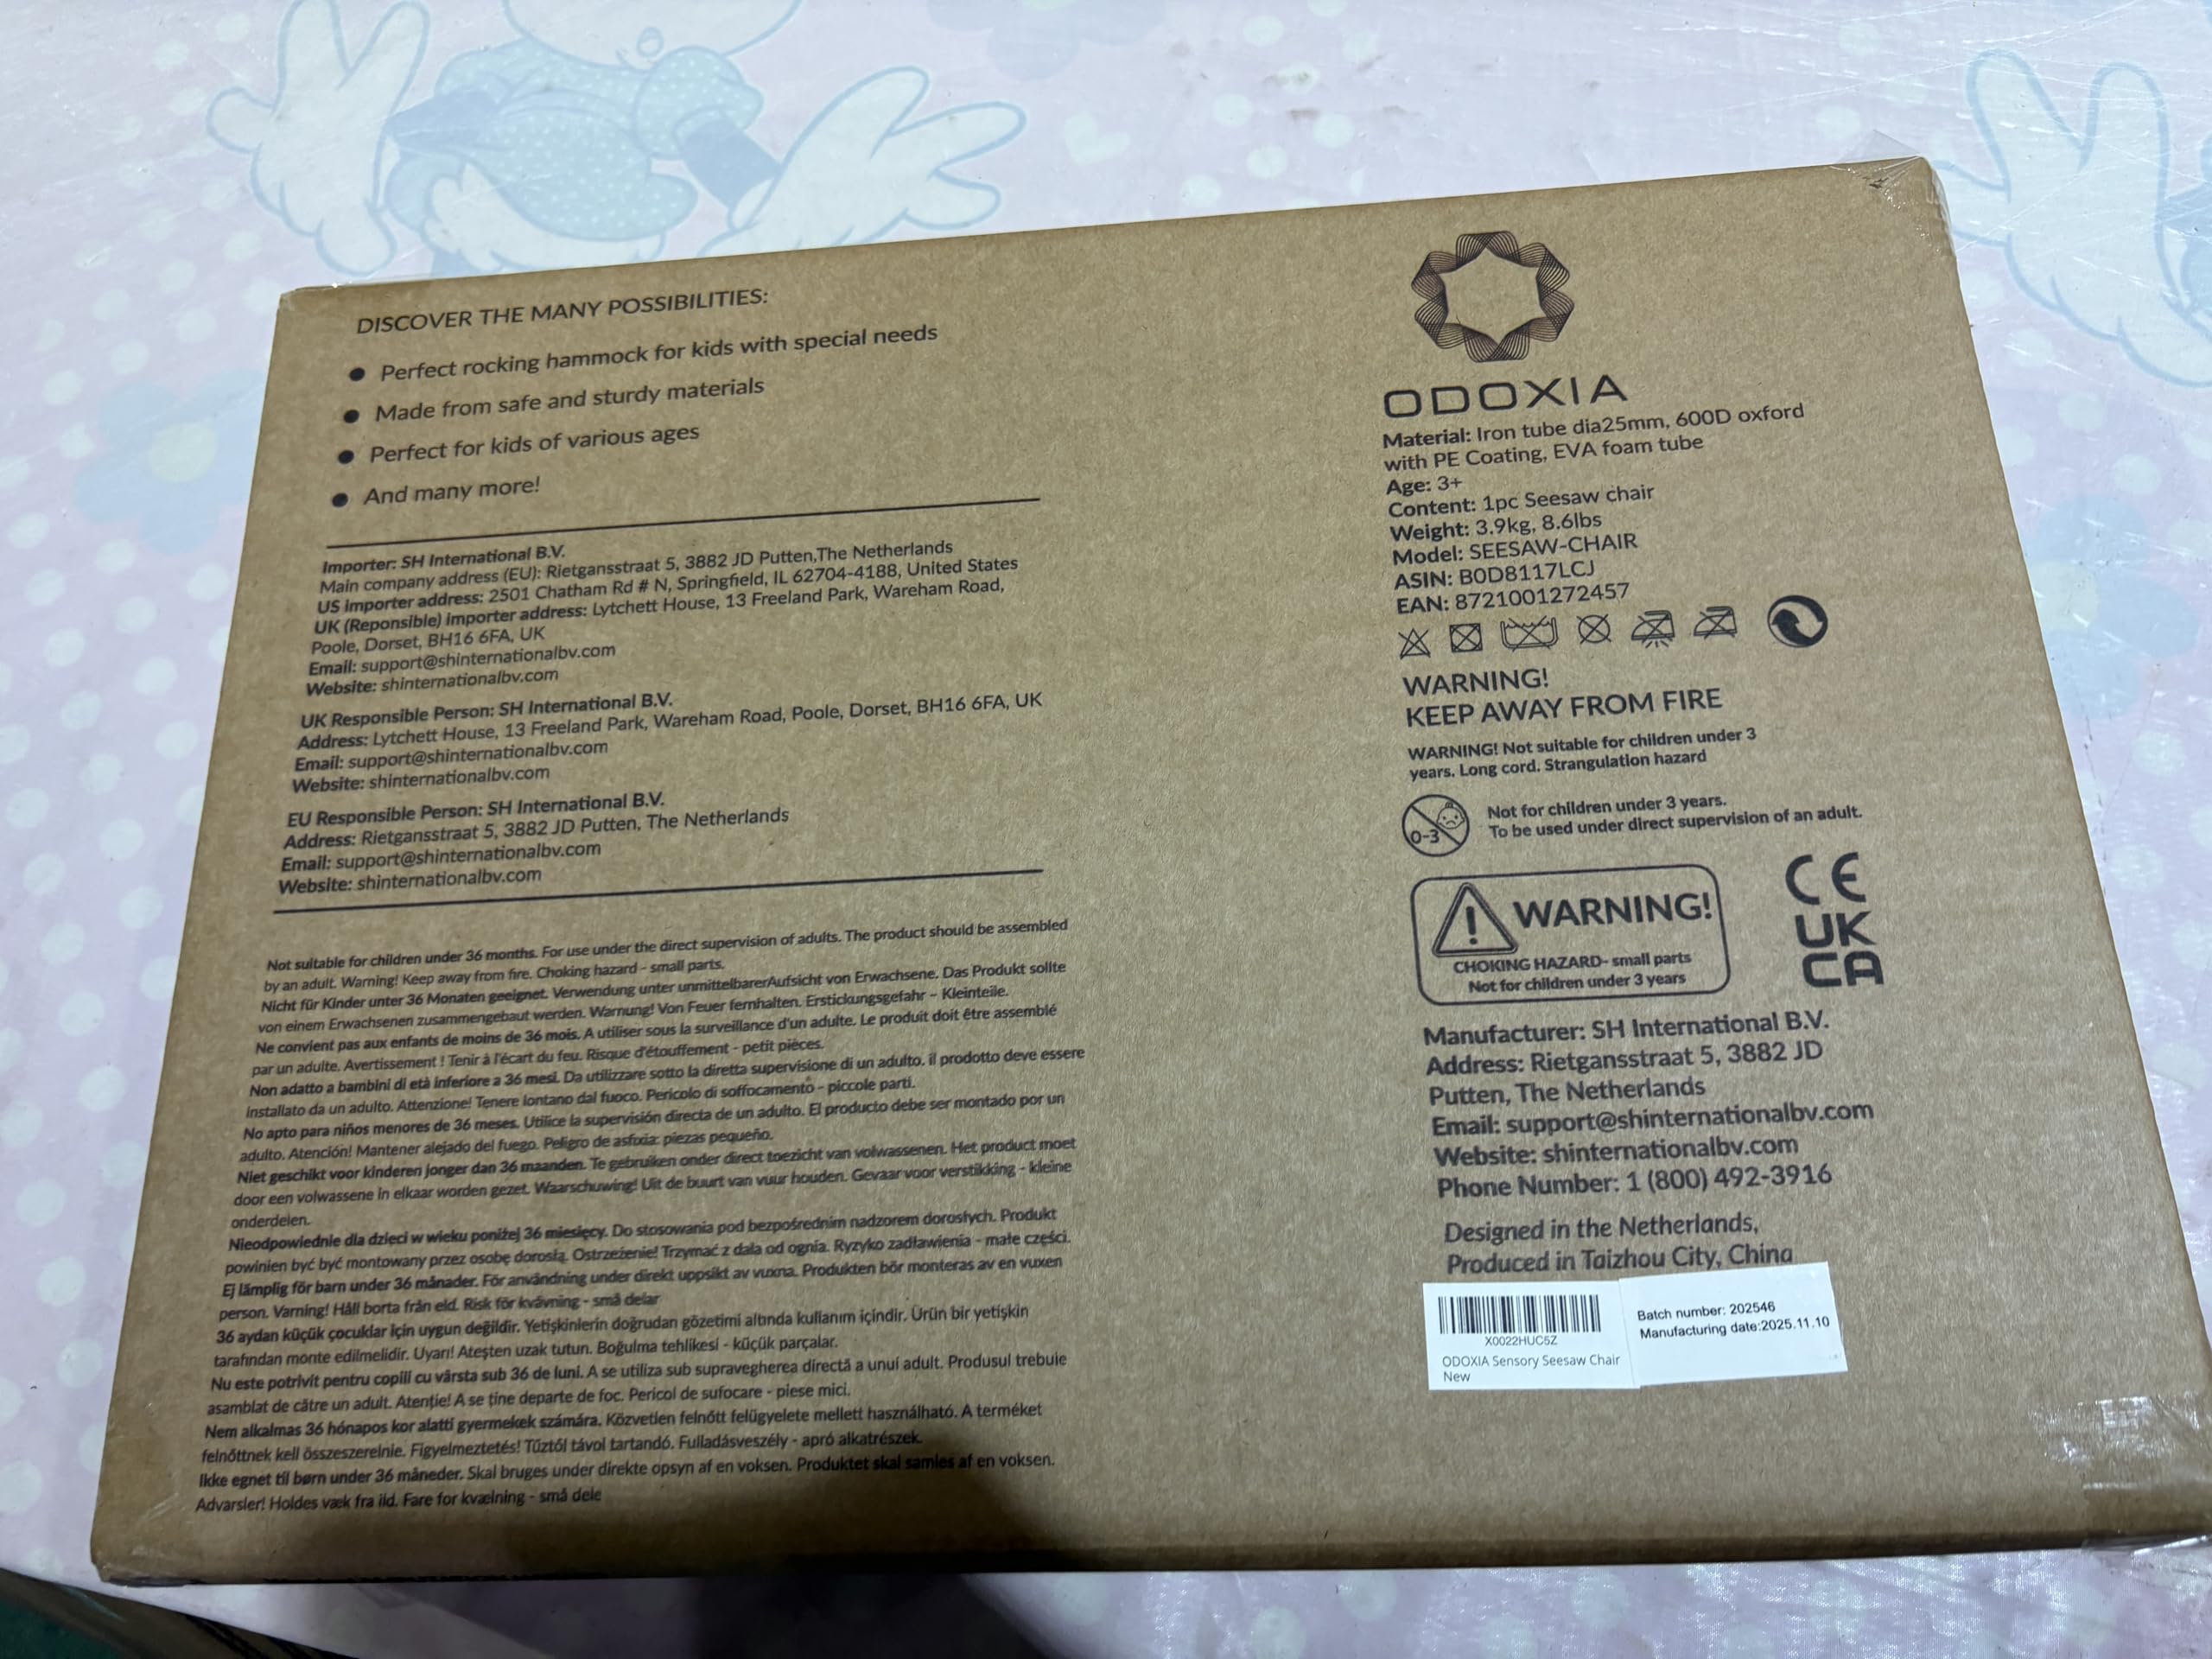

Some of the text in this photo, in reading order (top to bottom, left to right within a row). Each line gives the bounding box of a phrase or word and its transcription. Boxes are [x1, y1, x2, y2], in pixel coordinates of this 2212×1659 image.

[356, 289, 767, 334] DISCOVER THE MANY POSSIBILITIES:
[381, 324, 938, 380] Perfect rocking hammock for kids with special needs
[375, 377, 764, 421] Made from safe and sturdy materials
[1383, 375, 1628, 417] ODOXIA
[1382, 403, 1804, 448] Material: Iron tube dia25mm, 600D oxford
[1383, 435, 1704, 471] with PE Coating, EVA foam tube
[363, 476, 539, 505] And many more!
[1386, 475, 1462, 496] Age: 3+
[1388, 484, 1654, 517] Content: 1pc Seesaw chair
[1389, 512, 1601, 542] Weight: 3.9kg, 8.6lbs
[321, 544, 565, 574] Importer: SH International B.V.
[1392, 533, 1638, 565] Model: SEESAW-CHAIR
[317, 558, 1018, 613] US importer address: 2501 Chatham Rd # N, Springfield, IL 62704-4188, United States
[1394, 560, 1594, 589] ASIN: B0D8117LCJ
[1396, 582, 1630, 613] EAN: 8721001272457
[308, 645, 615, 676] Email: support@shinternationalbv.com
[306, 670, 558, 696] Website: shinternationalbv.com
[1402, 668, 1548, 695] WARNING!
[1406, 688, 1722, 727] KEEP AWAY FROM FIRE
[1407, 727, 1756, 760] WARNING! Not suitable for children under 3
[1411, 830, 1440, 844] 0-3
[1512, 891, 1713, 927] WARNING!
[264, 980, 281, 994] by
[281, 981, 298, 991] an
[301, 977, 336, 990] adult.
[340, 975, 398, 988] Warning!
[402, 974, 434, 986] Keep
[436, 973, 472, 984] away
[474, 969, 505, 982] from
[507, 967, 532, 980] fire.
[536, 965, 591, 979] Choking
[593, 962, 638, 976] hazard
[649, 959, 684, 973] small
[687, 959, 724, 973] parts.
[1452, 952, 1692, 973] CHOKING HAZARD- small parts
[1423, 1009, 1828, 1045] Manufacturer: SH International B.V.
[1426, 1039, 1822, 1075] Address: Rietgansstraat 5, 3882 JD
[1429, 1077, 1706, 1105] Putten, The Netherlands
[1431, 1103, 1873, 1135] Email: support@shinternationalbv.com
[1433, 1136, 1798, 1166] Website: shinternationalbv.com
[1437, 1163, 1832, 1198] Phone Number: 1 (800) 492-3916
[1444, 1212, 1758, 1245] Designed in the Netherlands,
[1446, 1241, 1794, 1274] Produced in Taizhou City, China
[1637, 1301, 1775, 1320] Batch number: 202546
[1484, 1332, 1557, 1345] X0022HUC5Z
[1639, 1316, 1829, 1338] Manufacturing date:2025.11.10
[1441, 1354, 1620, 1369] ODOXIA Sensory Seesaw Chair
[1443, 1370, 1470, 1382] New
